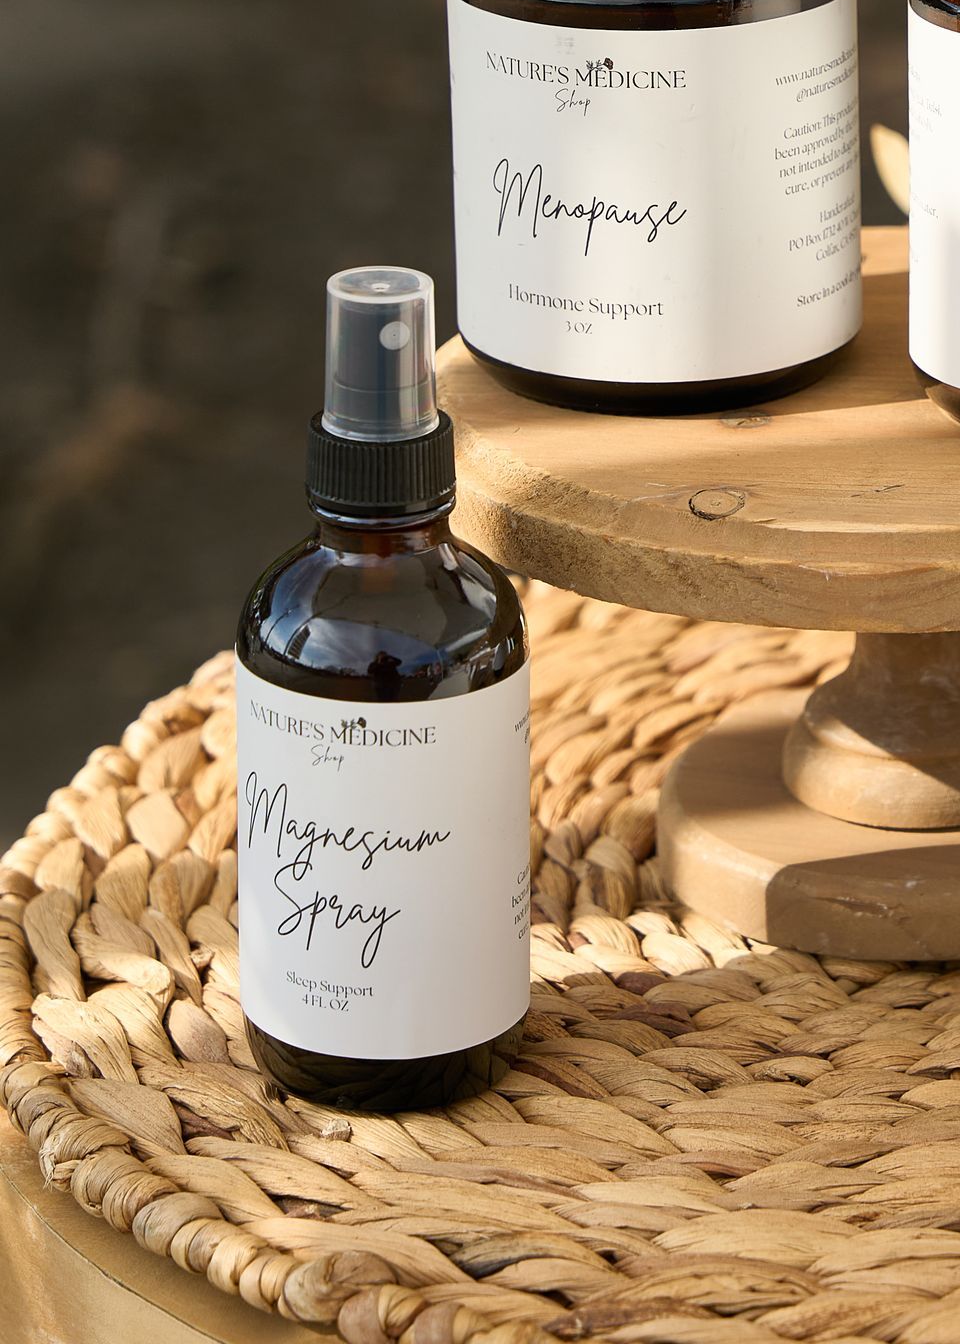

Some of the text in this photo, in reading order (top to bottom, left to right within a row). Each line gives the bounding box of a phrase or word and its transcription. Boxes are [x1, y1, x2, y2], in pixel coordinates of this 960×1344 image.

[485, 51, 687, 89] NATURE'S MEDICINE
[554, 88, 592, 116] Shop
[774, 145, 801, 160] been
[779, 164, 796, 178] not
[784, 181, 810, 196] cure,
[492, 158, 688, 257] Menopause
[789, 236, 804, 251] PO
[508, 283, 664, 321] Hormone Support
[796, 290, 822, 307] Store
[565, 320, 593, 335] 3 OZ
[250, 699, 437, 747] NATURE'S MEDICINE
[311, 744, 346, 771] Shop
[245, 771, 451, 882] Magnesium
[273, 861, 402, 969] Spray
[286, 970, 374, 999] Sleep Support
[329, 997, 350, 1012] OZ
